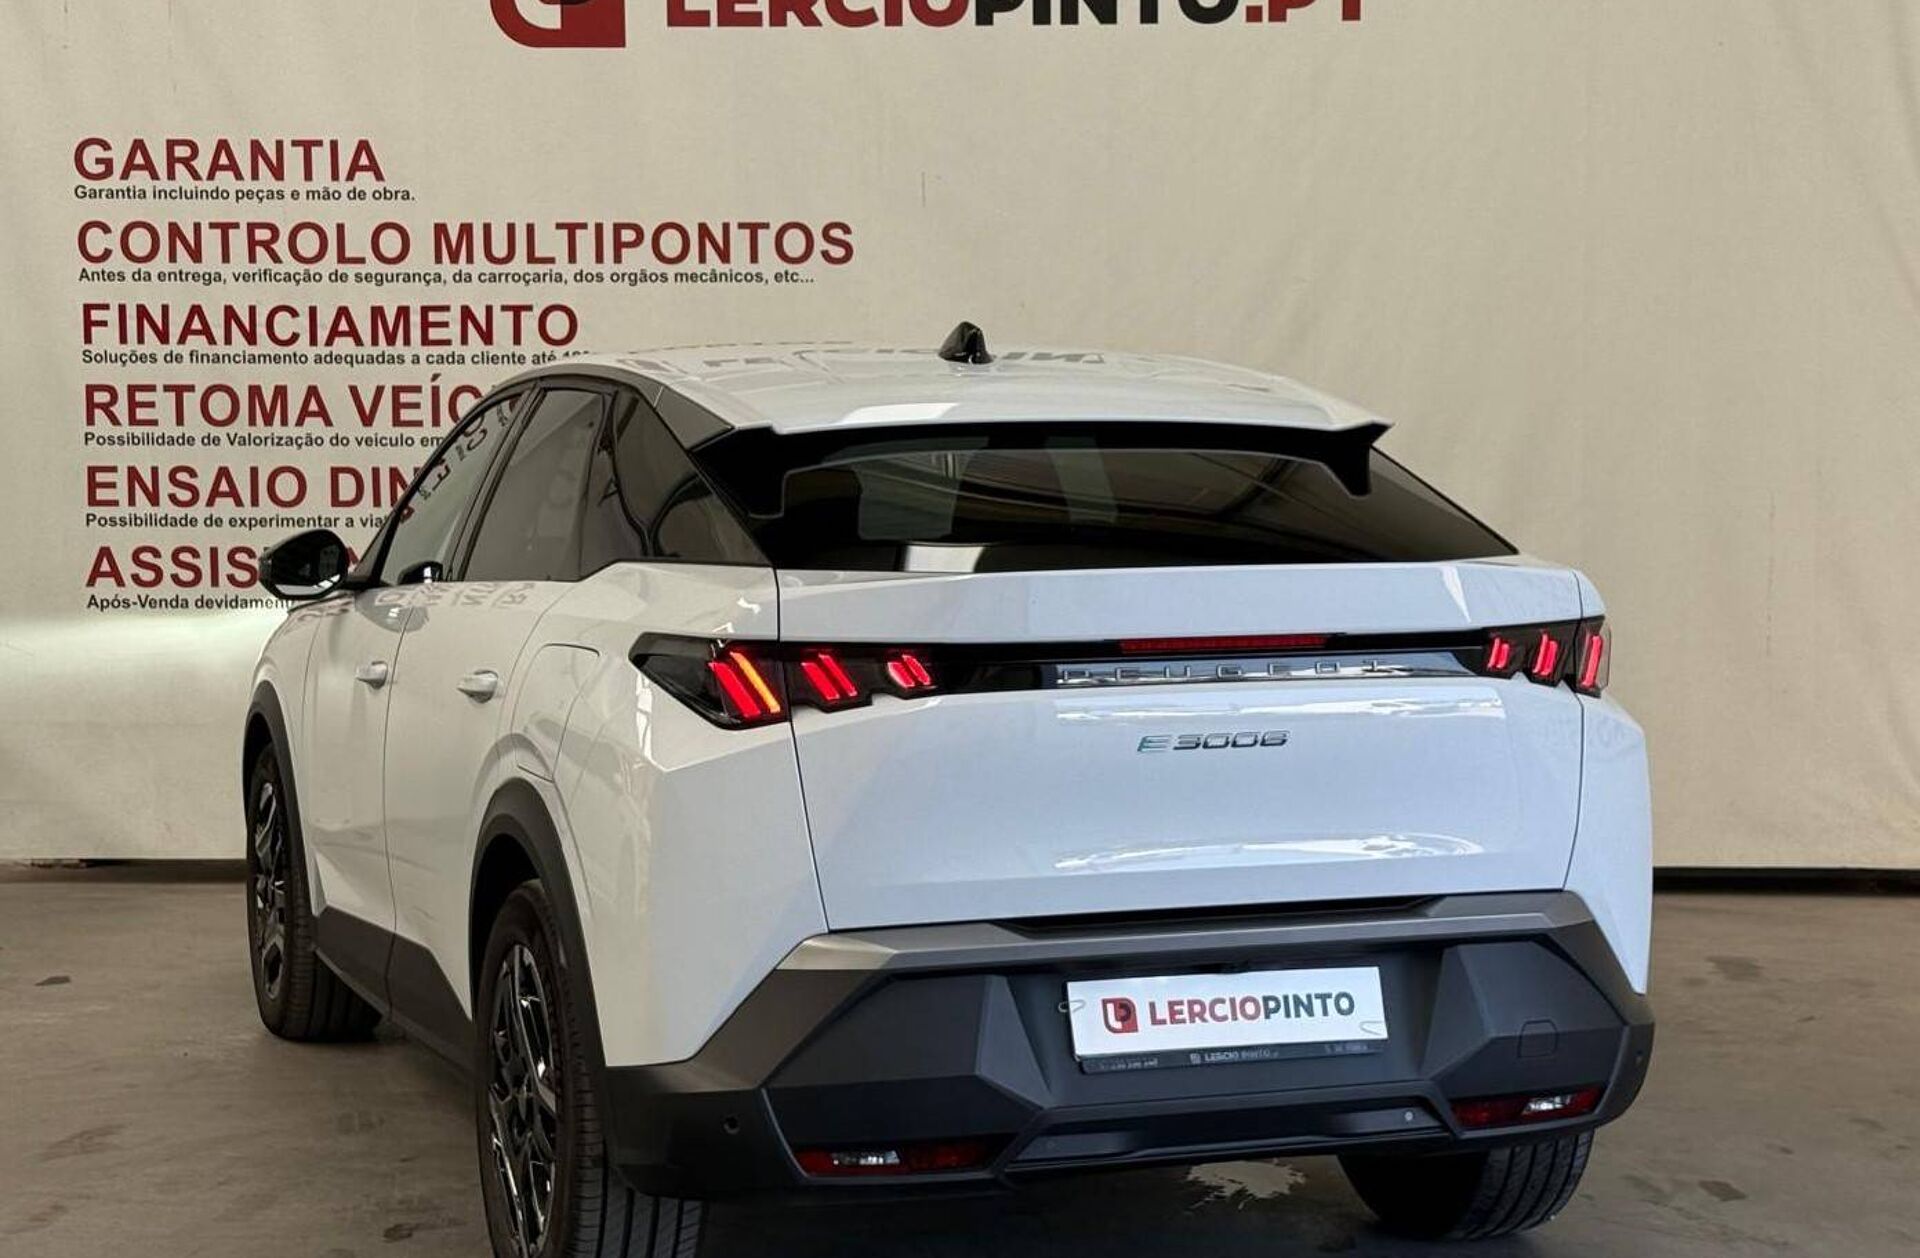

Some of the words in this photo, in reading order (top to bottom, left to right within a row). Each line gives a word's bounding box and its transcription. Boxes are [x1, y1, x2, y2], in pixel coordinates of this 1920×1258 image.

[74, 138, 386, 182] GARANTIA
[74, 185, 147, 200] Garantia
[153, 185, 230, 201] incluindo
[235, 188, 286, 204] peças
[291, 189, 301, 201] e
[306, 187, 342, 202] mão
[347, 186, 368, 201] de
[372, 187, 416, 202] obra.
[78, 220, 411, 265] CONTROLO
[434, 221, 855, 265] MULTIPONTOS
[79, 268, 127, 282] Antes
[132, 268, 152, 282] da
[157, 269, 227, 285] entrega,
[232, 267, 323, 286] verificação
[328, 269, 349, 283] de
[354, 269, 447, 286] segurança,
[452, 269, 473, 283] da
[478, 269, 568, 287] carroçaria,
[574, 269, 605, 283] dos
[610, 269, 669, 287] orgãos
[674, 268, 769, 285] mecânicos,
[774, 270, 814, 284] etc...
[83, 303, 579, 348] FINANCIAMENTO
[82, 349, 158, 367] Soluções
[164, 350, 184, 364] de
[189, 350, 309, 365] financiamento
[314, 351, 406, 368] adequadas
[411, 354, 421, 365] a
[426, 351, 466, 365] cada
[471, 351, 526, 365] cliente
[85, 384, 335, 427] RETOMA
[348, 373, 490, 427] VEÍC
[84, 432, 196, 447] Possibilidade
[201, 433, 222, 447] de
[226, 432, 325, 450] Valorização
[329, 433, 351, 447] do
[87, 465, 307, 509] ENSAIO
[330, 466, 421, 509] DIN
[86, 513, 199, 528] Possibilidade
[204, 514, 224, 528] de
[229, 515, 338, 531] experimentar
[344, 517, 354, 528] a
[86, 546, 266, 589] ASSIS
[87, 594, 190, 612] Após-Venda
[1149, 991, 1356, 1026] LERCIOPINTO
